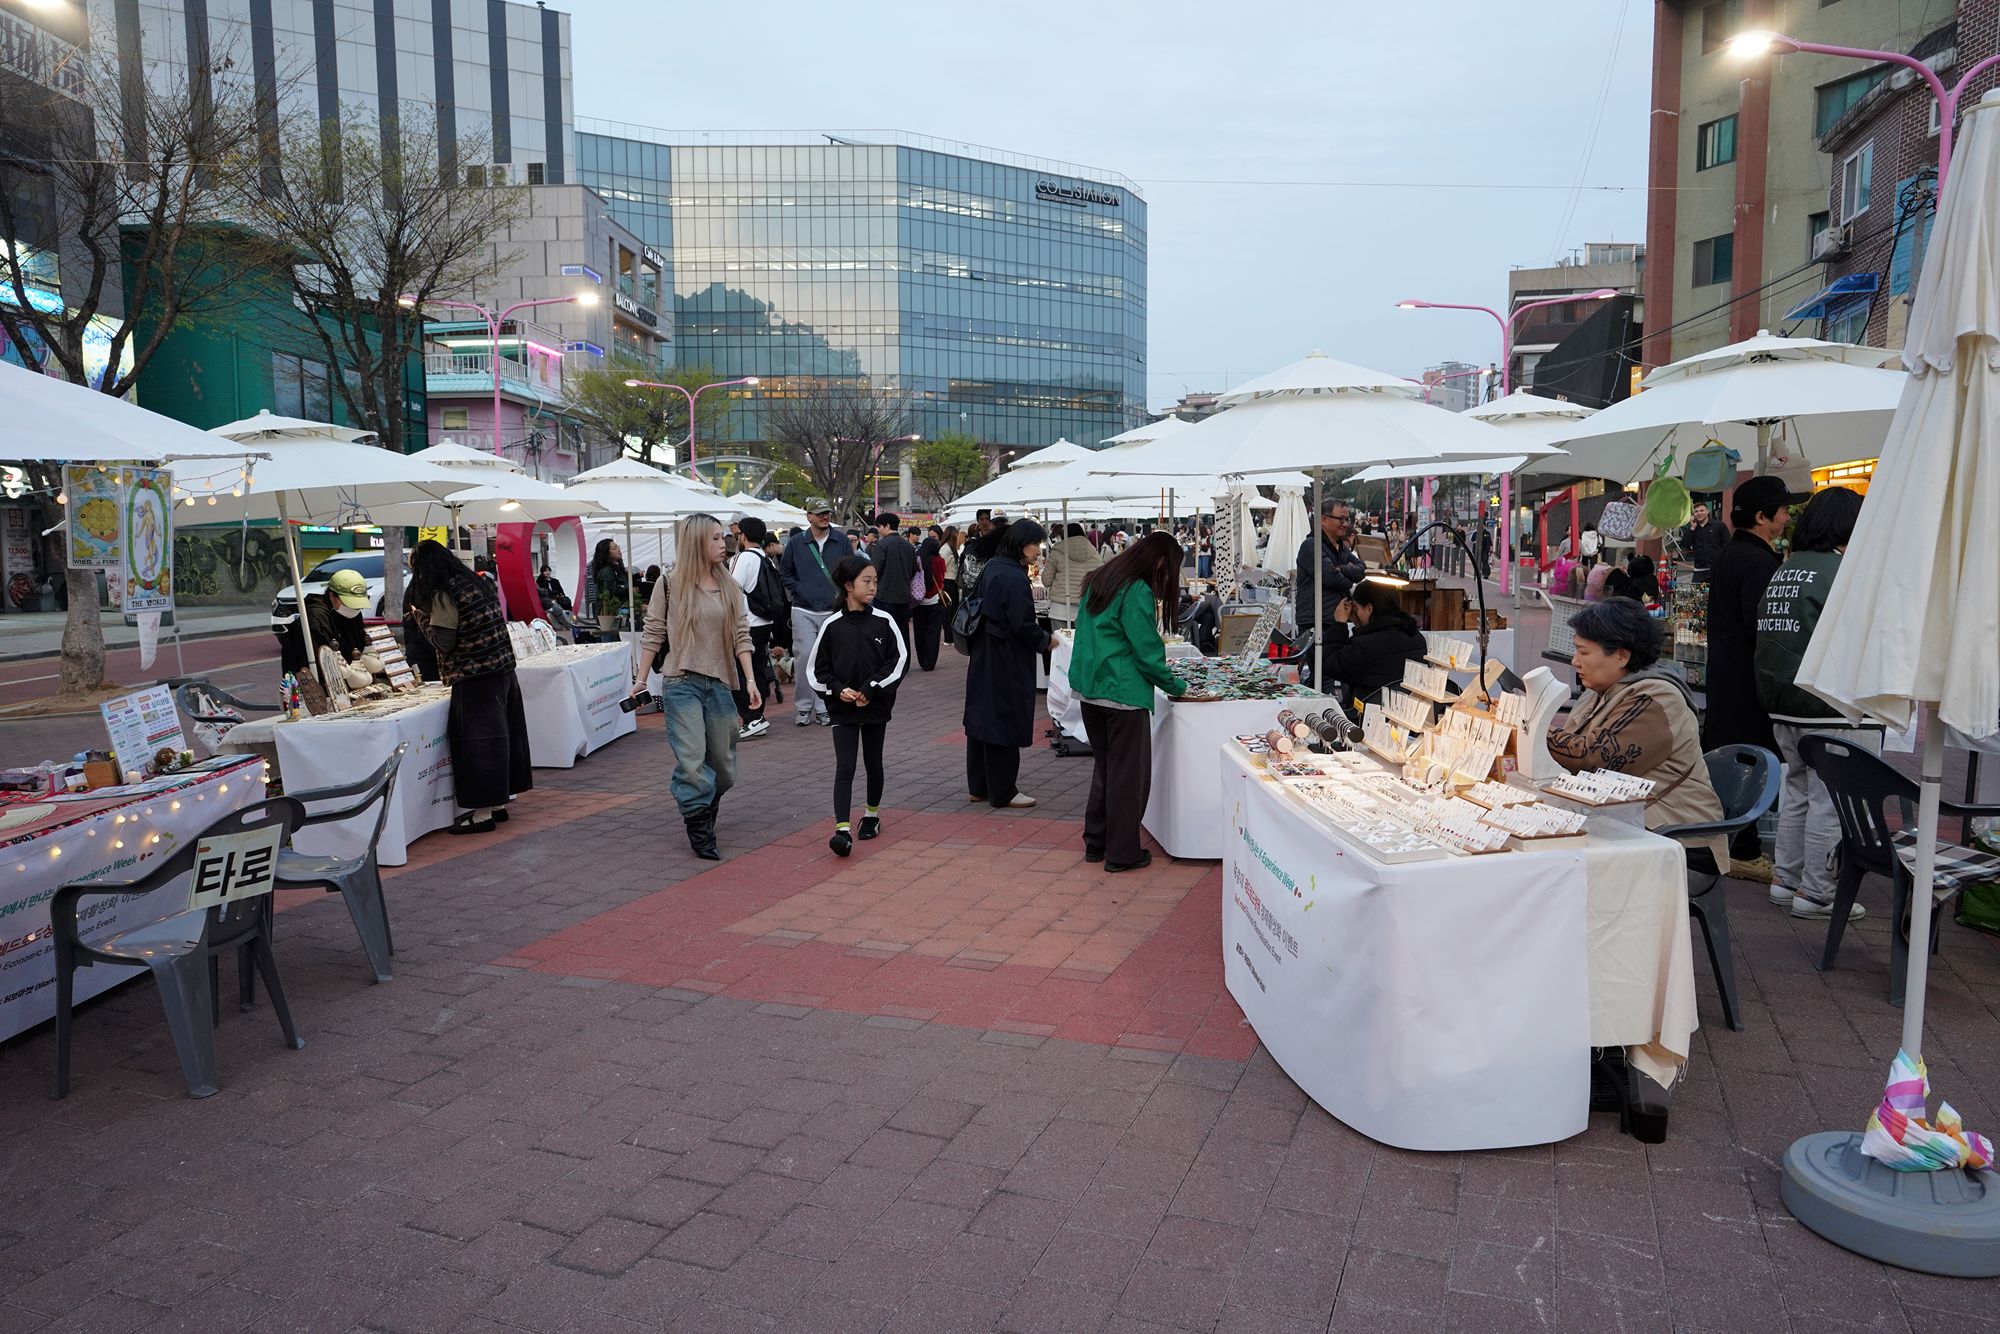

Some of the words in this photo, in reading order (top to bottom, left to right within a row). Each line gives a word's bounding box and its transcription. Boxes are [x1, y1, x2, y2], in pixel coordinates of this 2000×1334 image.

[1770, 569, 1818, 583] RACTICE
[1766, 585, 1800, 599] TRUTH
[1766, 601, 1791, 615] FEAR
[1757, 618, 1801, 633] NOTHING
[113, 854, 138, 870] Week
[195, 845, 273, 897] 타로
[1281, 872, 1296, 892] Week
[78, 895, 119, 922] 제활성화
[2, 949, 42, 971] Economic
[95, 915, 117, 930] Event
